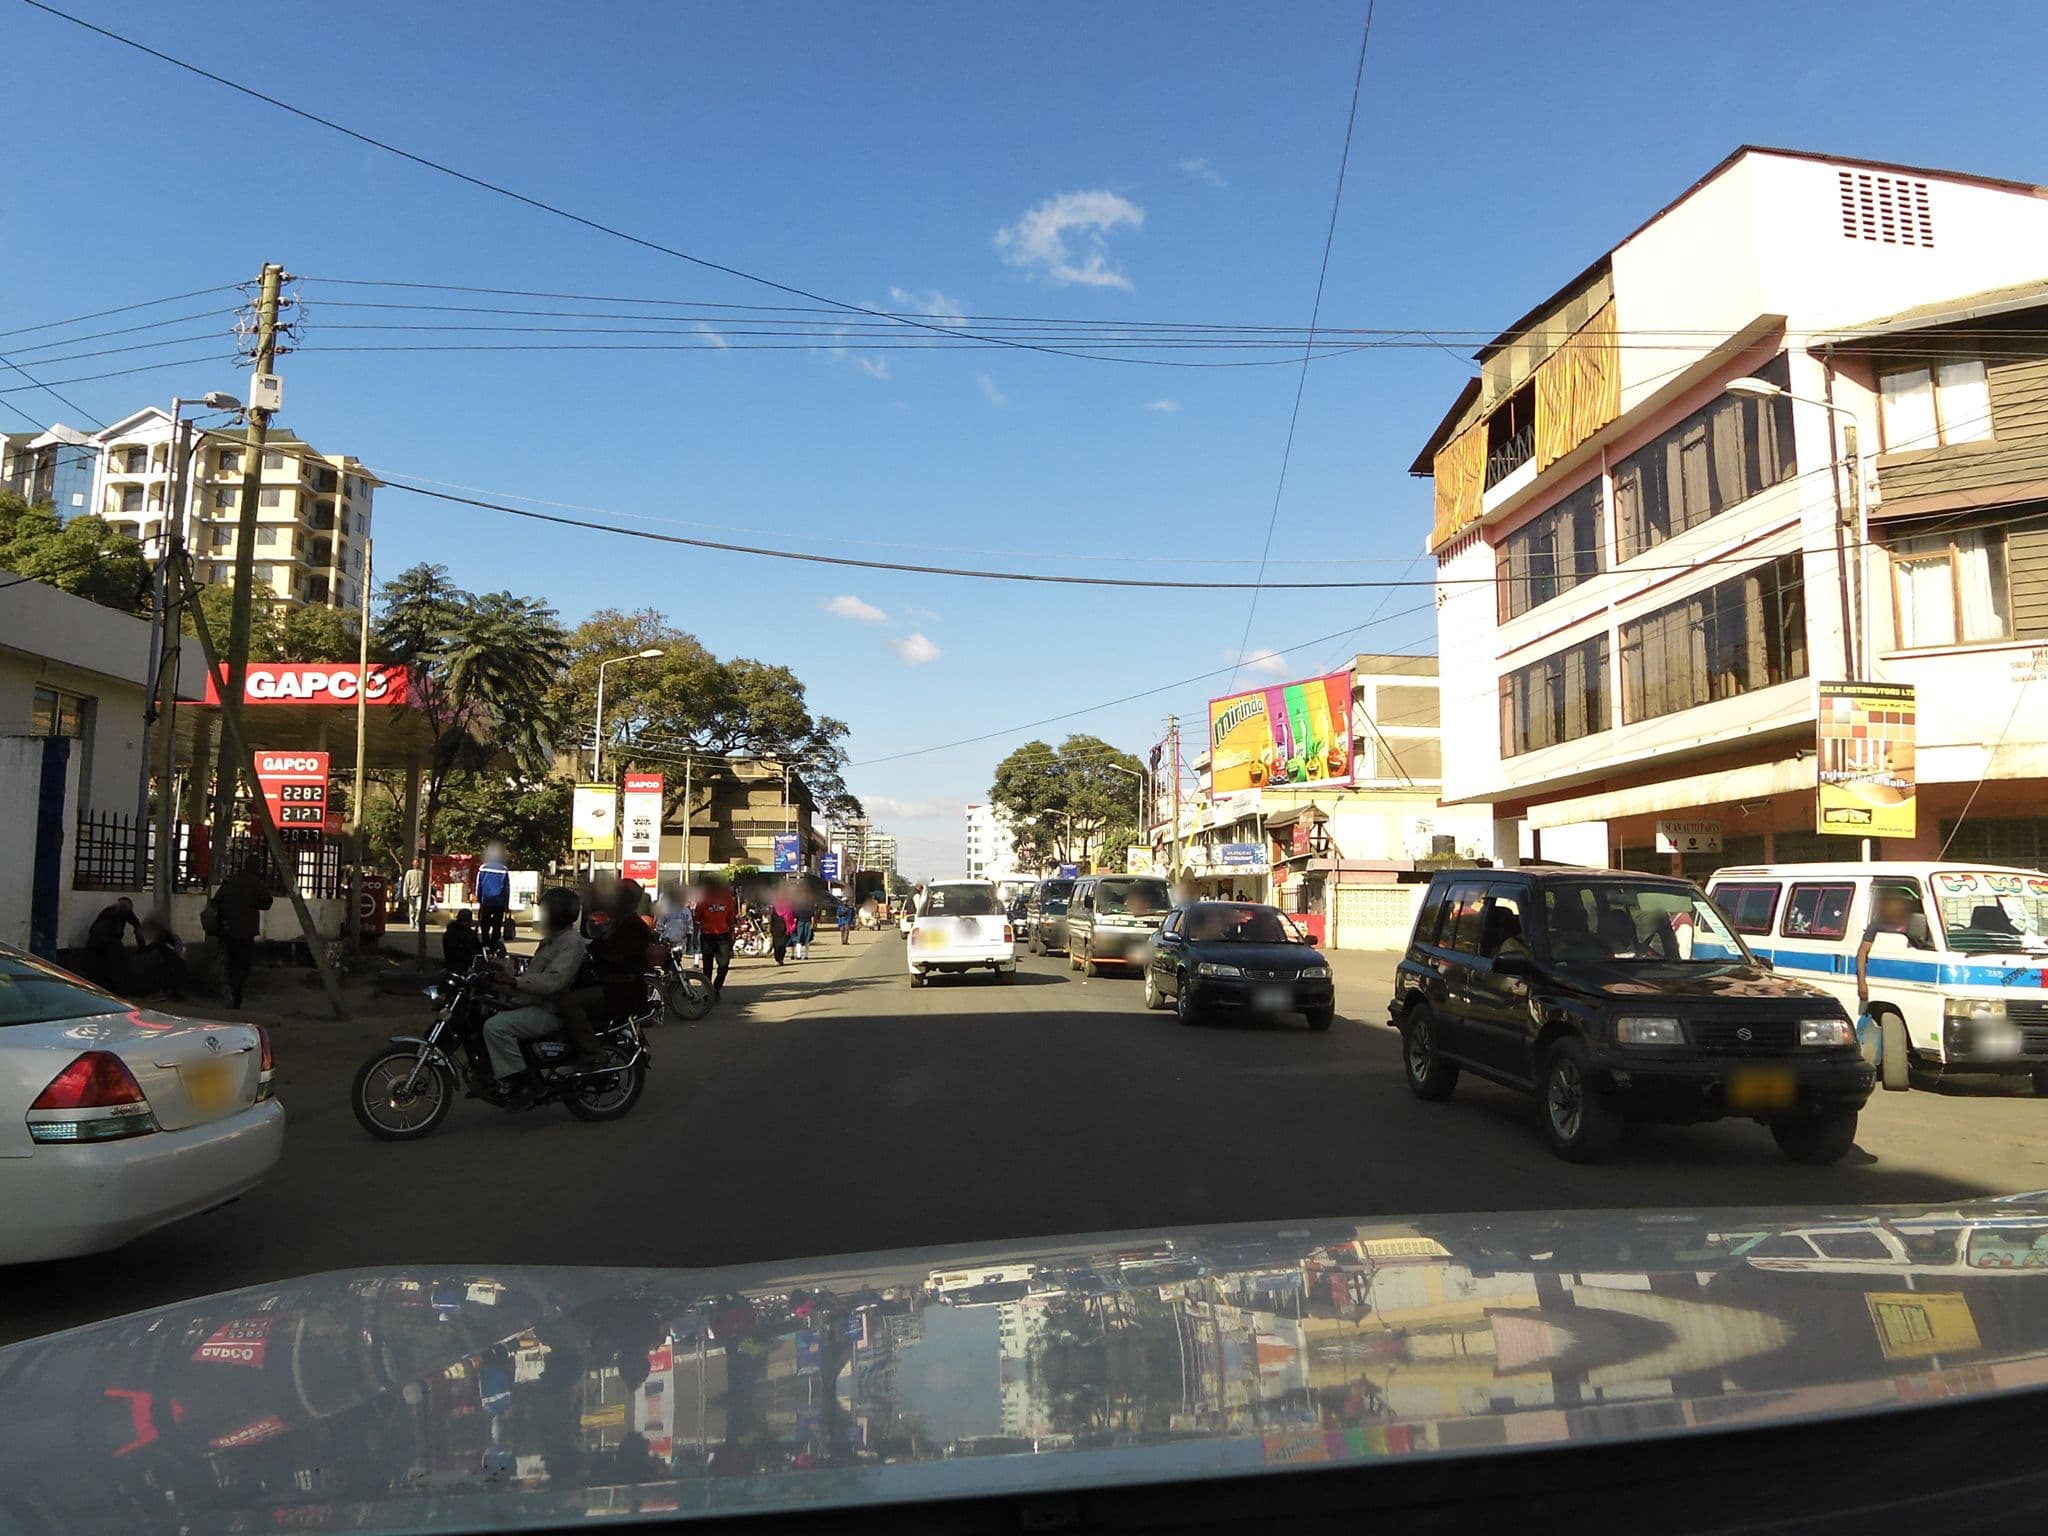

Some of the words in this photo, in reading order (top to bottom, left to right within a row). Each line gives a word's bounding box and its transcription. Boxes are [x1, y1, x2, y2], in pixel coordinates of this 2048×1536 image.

[246, 671, 388, 699] GAPCO
[263, 757, 319, 772] GAPCO
[627, 781, 660, 789] GAPCO
[283, 786, 322, 800] 2282
[282, 807, 321, 821] 2127
[1681, 823, 1699, 833] AUTO
